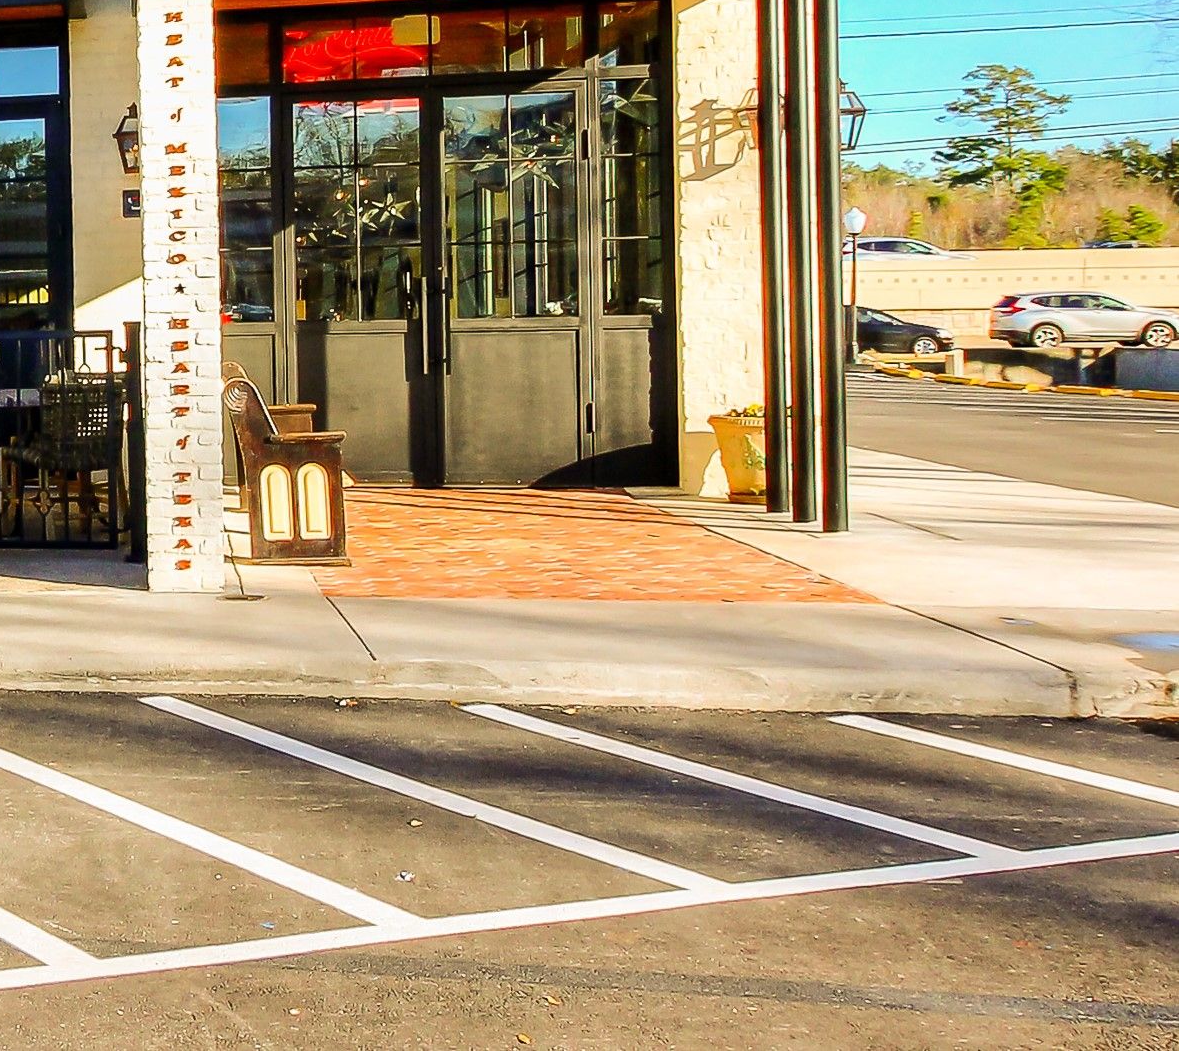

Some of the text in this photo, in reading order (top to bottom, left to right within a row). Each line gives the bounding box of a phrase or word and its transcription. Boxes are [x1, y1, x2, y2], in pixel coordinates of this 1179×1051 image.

[163, 11, 193, 571] HEAT of MEXICO HEART of TEXAS
